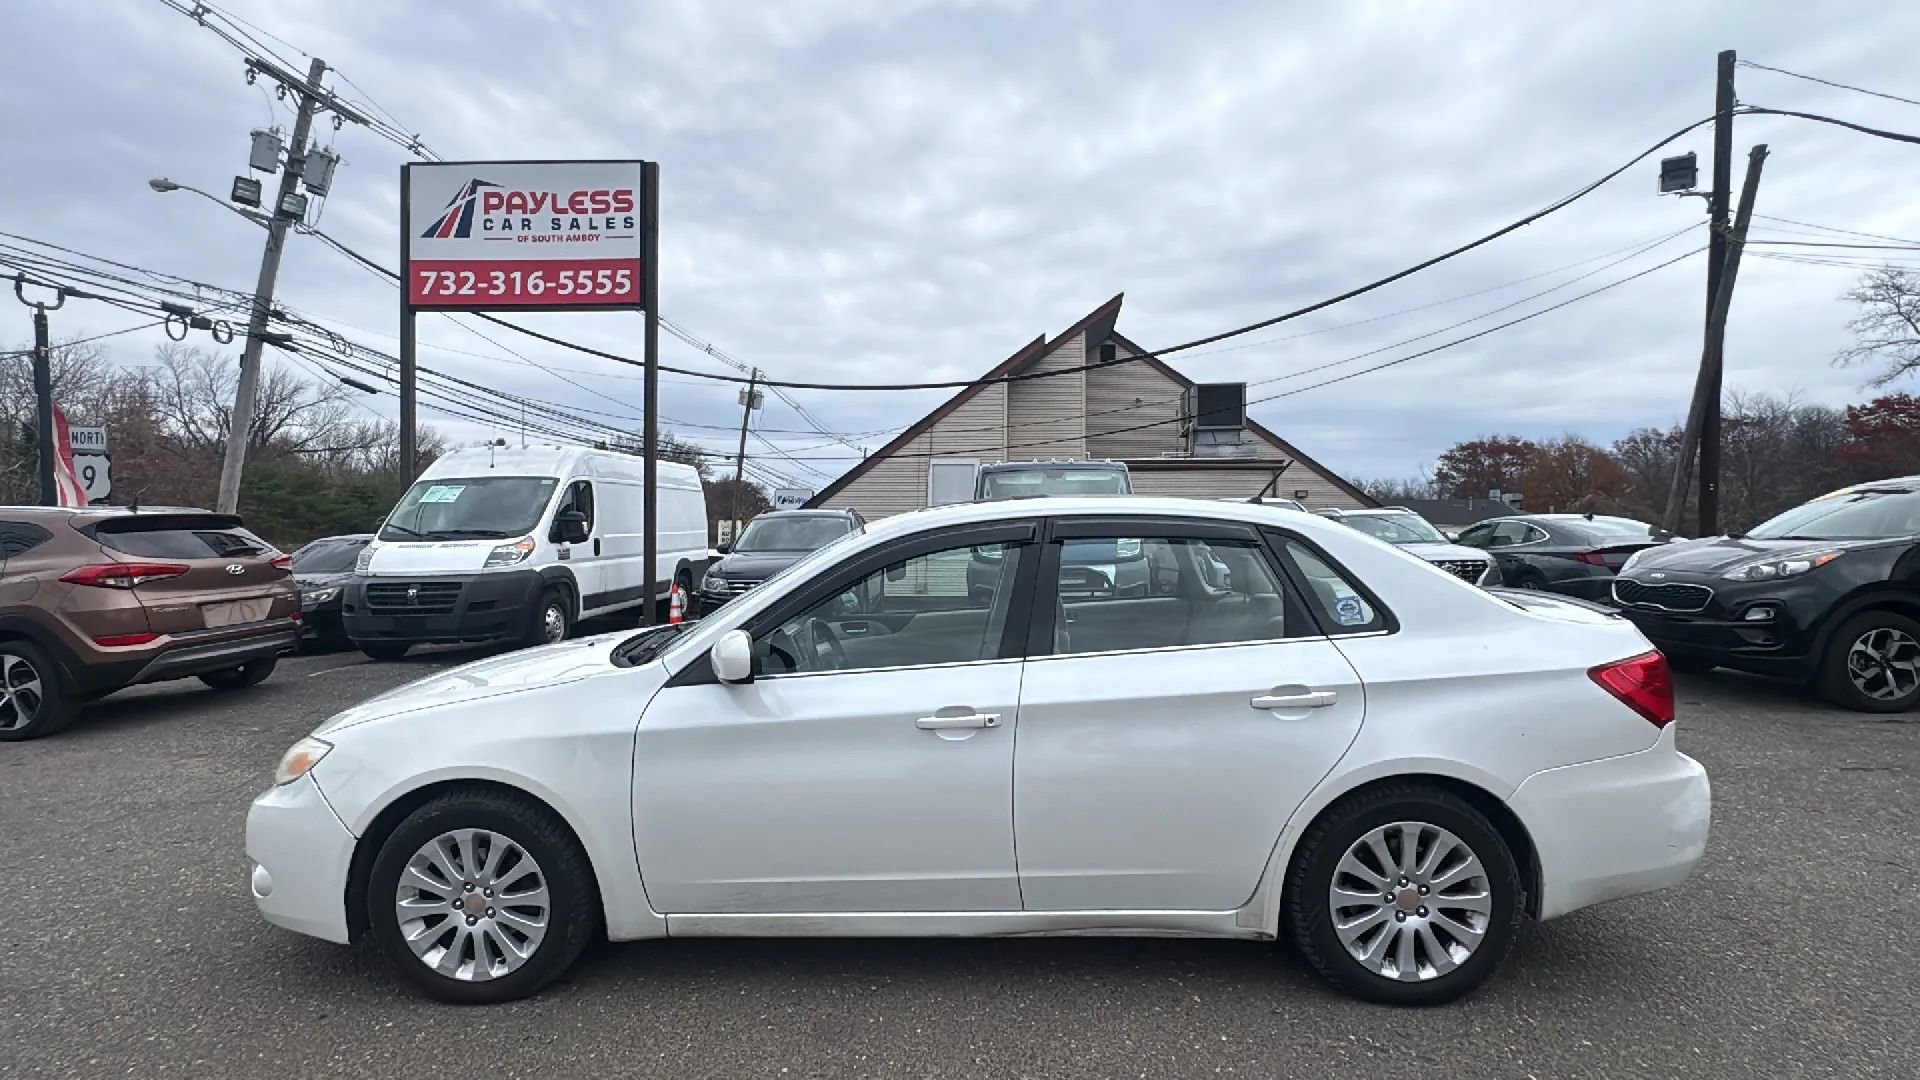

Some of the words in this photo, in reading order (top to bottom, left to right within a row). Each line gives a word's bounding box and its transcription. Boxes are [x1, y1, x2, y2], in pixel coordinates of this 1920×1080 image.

[483, 190, 634, 215] PAYLESS
[483, 217, 532, 231] CAR
[551, 216, 634, 230] SALES
[516, 235, 529, 243] OF
[531, 234, 563, 243] SOUTH
[565, 233, 600, 242] AMBOY
[419, 269, 631, 296] 732-316-5555
[83, 465, 96, 490] 9
